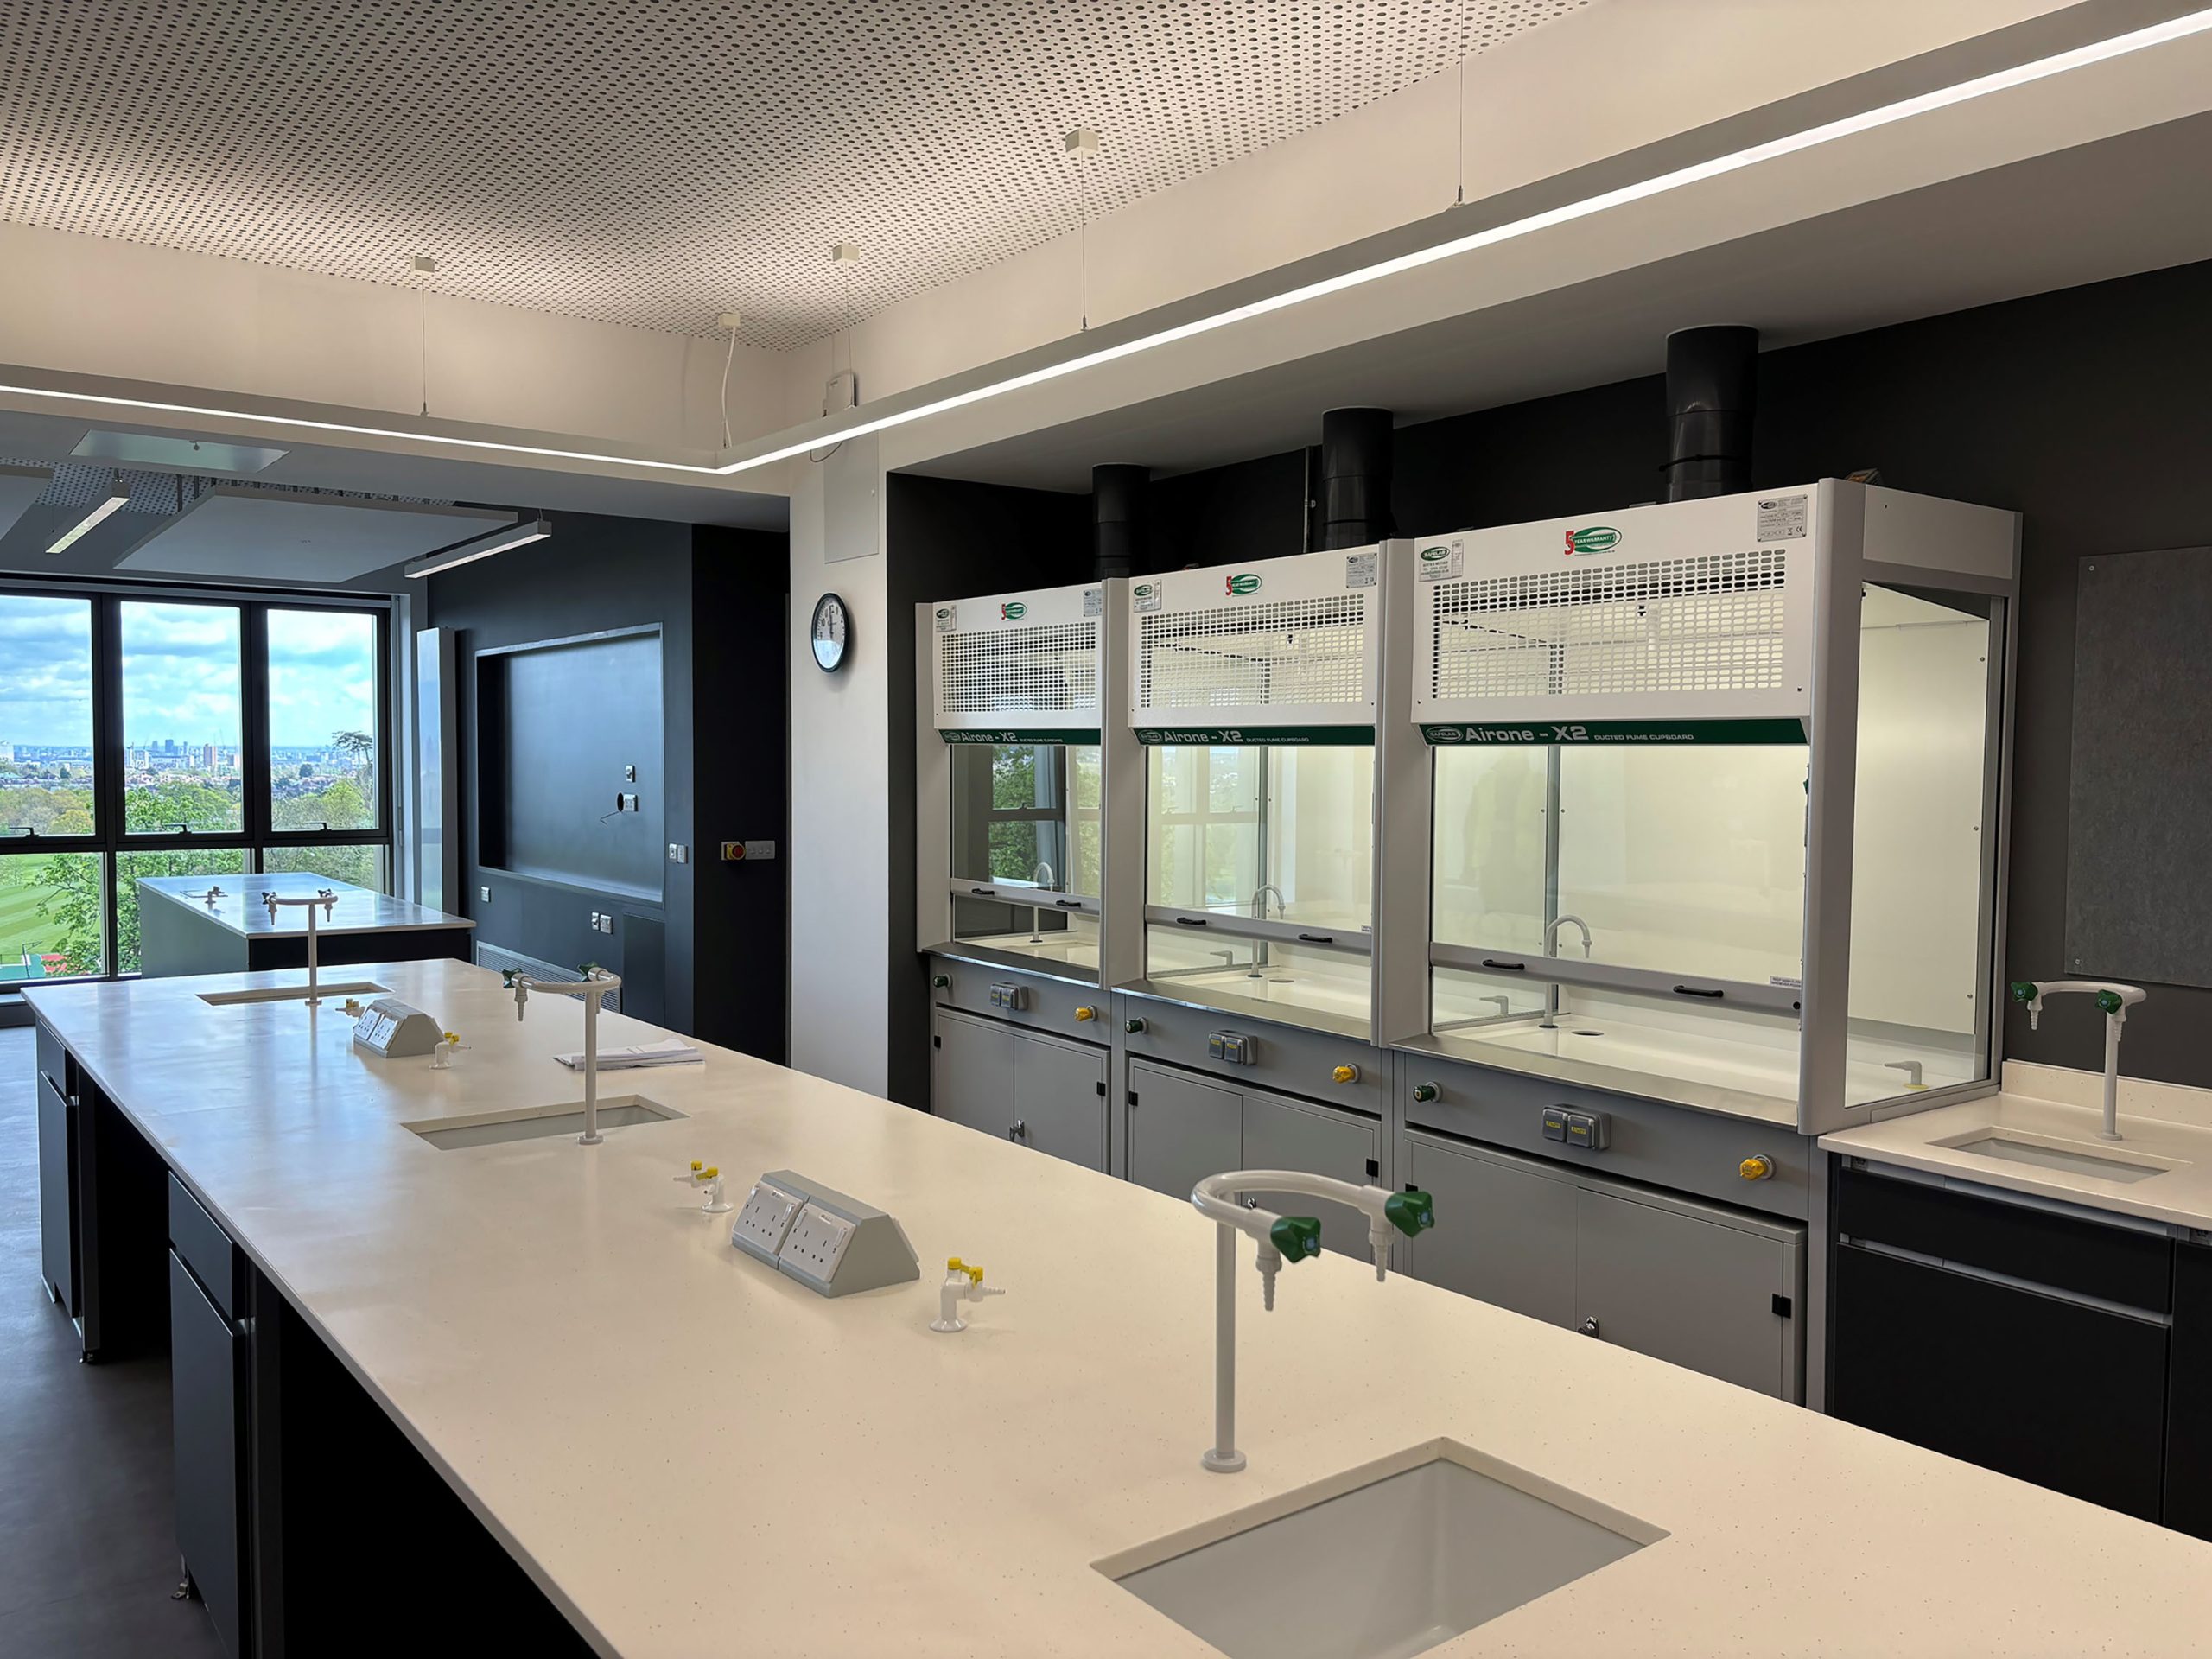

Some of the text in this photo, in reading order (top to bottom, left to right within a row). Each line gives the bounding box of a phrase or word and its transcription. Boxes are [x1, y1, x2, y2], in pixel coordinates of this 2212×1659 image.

[1564, 530, 1575, 556] 5
[1225, 575, 1232, 595] 5
[961, 732, 994, 742] Airone
[1000, 731, 1019, 742] X2
[1164, 731, 1209, 742] Airone
[1217, 730, 1243, 742] X2
[1465, 727, 1535, 741] Airone
[1551, 726, 1590, 741] X2
